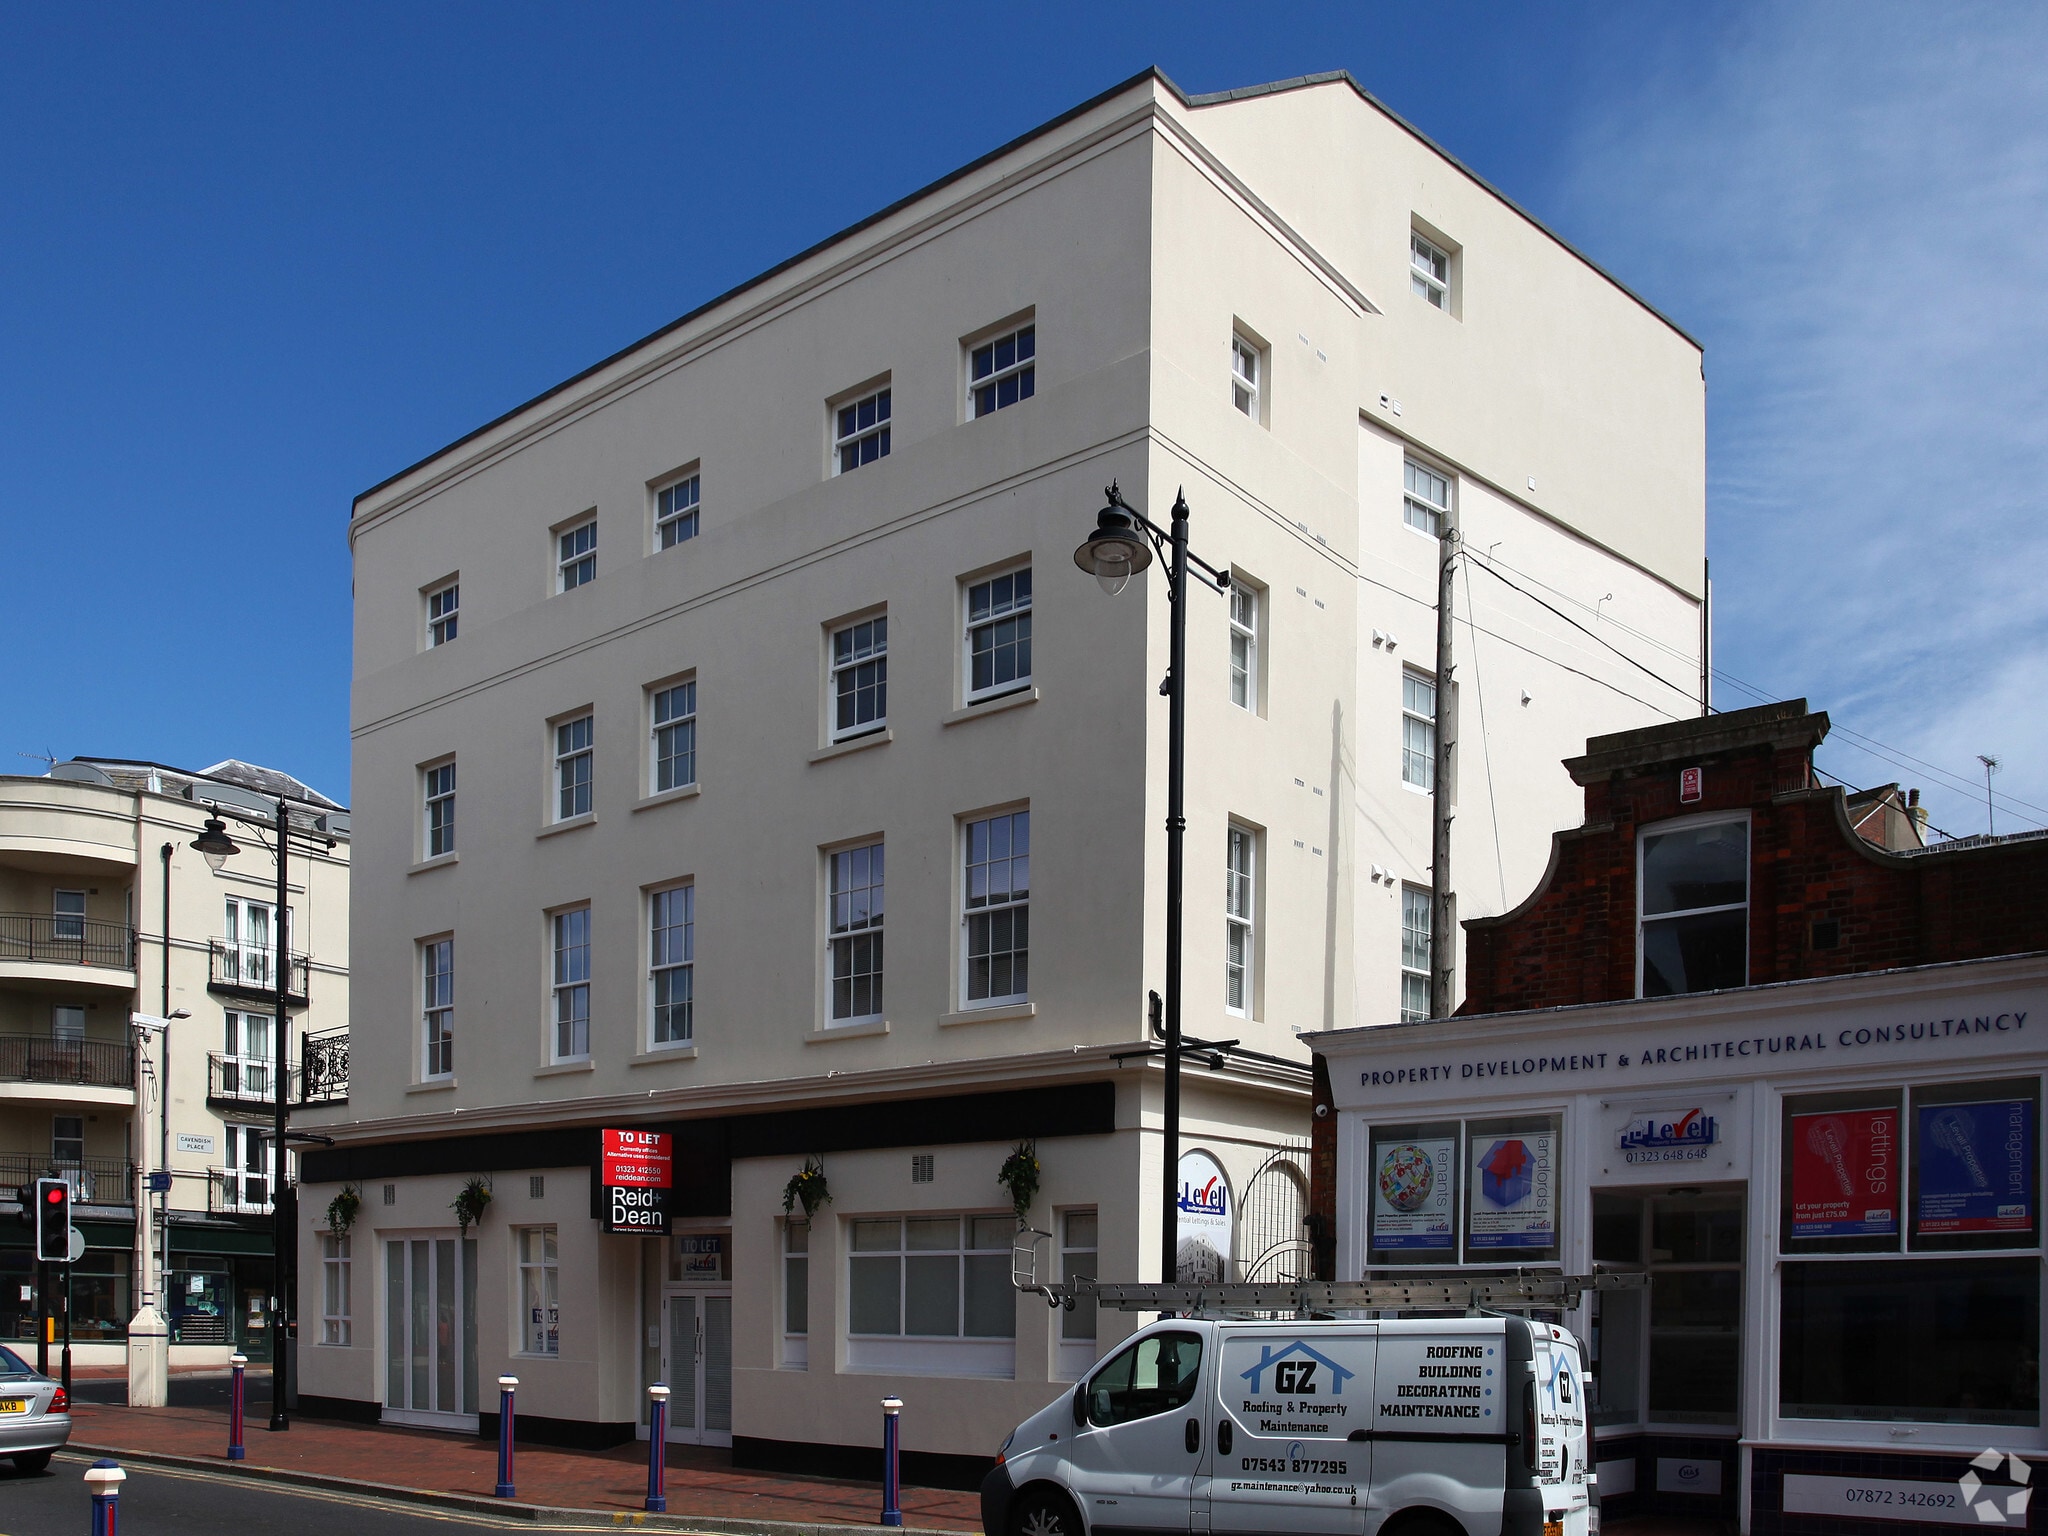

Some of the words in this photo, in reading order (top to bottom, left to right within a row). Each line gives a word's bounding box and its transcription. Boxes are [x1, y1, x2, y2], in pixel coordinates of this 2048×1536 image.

[1361, 1065, 1452, 1086] PROPERTY
[1462, 1053, 1608, 1078] DEVELOPMENT
[1618, 1054, 1630, 1067] &
[1641, 1033, 1826, 1065] ARCHITECTURAL
[1838, 1012, 2027, 1046] CONSULTANCY
[1647, 1108, 1714, 1140] Levell
[180, 1136, 212, 1144] CAVENDISH
[618, 1131, 634, 1143] TO
[638, 1133, 660, 1145] LET
[186, 1143, 205, 1151] PLACE
[2005, 1102, 2024, 1195] management
[607, 1151, 633, 1159] Alternative
[1626, 1151, 1660, 1163] 01323
[1662, 1149, 1684, 1161] 648
[1687, 1147, 1708, 1160] 648
[1866, 1116, 1892, 1194] lettings
[615, 1165, 636, 1173] 01323
[637, 1166, 661, 1174] 412550
[1537, 1135, 1552, 1208] landlords
[615, 1174, 661, 1182] reiddean.com
[1437, 1147, 1450, 1207] tenants
[1185, 1175, 1226, 1209] Levell
[1807, 1203, 1822, 1211] your
[1822, 1200, 1850, 1210] property
[612, 1205, 662, 1225] Dean
[1192, 1216, 1210, 1227] Lettings
[1215, 1218, 1226, 1227] Sales
[1825, 1210, 1848, 1219] £75.00
[684, 1239, 698, 1252] TO
[700, 1239, 718, 1252] LET
[1426, 1346, 1483, 1359] ROOFING
[1275, 1361, 1318, 1395] GZ
[1418, 1365, 1482, 1378] BUILDING
[1397, 1384, 1481, 1398] DECORATING
[1242, 1400, 1283, 1416] Roofing
[1286, 1401, 1295, 1413] &
[1299, 1401, 1348, 1417] Property
[1379, 1404, 1480, 1418] MAINTENANCE
[1797, 1406, 1835, 1419] Planning
[1853, 1407, 1892, 1419] Building
[1968, 1410, 2017, 1424] Feasibility
[1260, 1419, 1329, 1433] Maintenance
[1242, 1457, 1286, 1472] 07543
[1292, 1459, 1347, 1475] 877295
[1231, 1480, 1357, 1496] gz.maintenance@yahoo.co.uk
[1846, 1488, 1893, 1504] 07872
[1898, 1491, 1956, 1508] 342692
